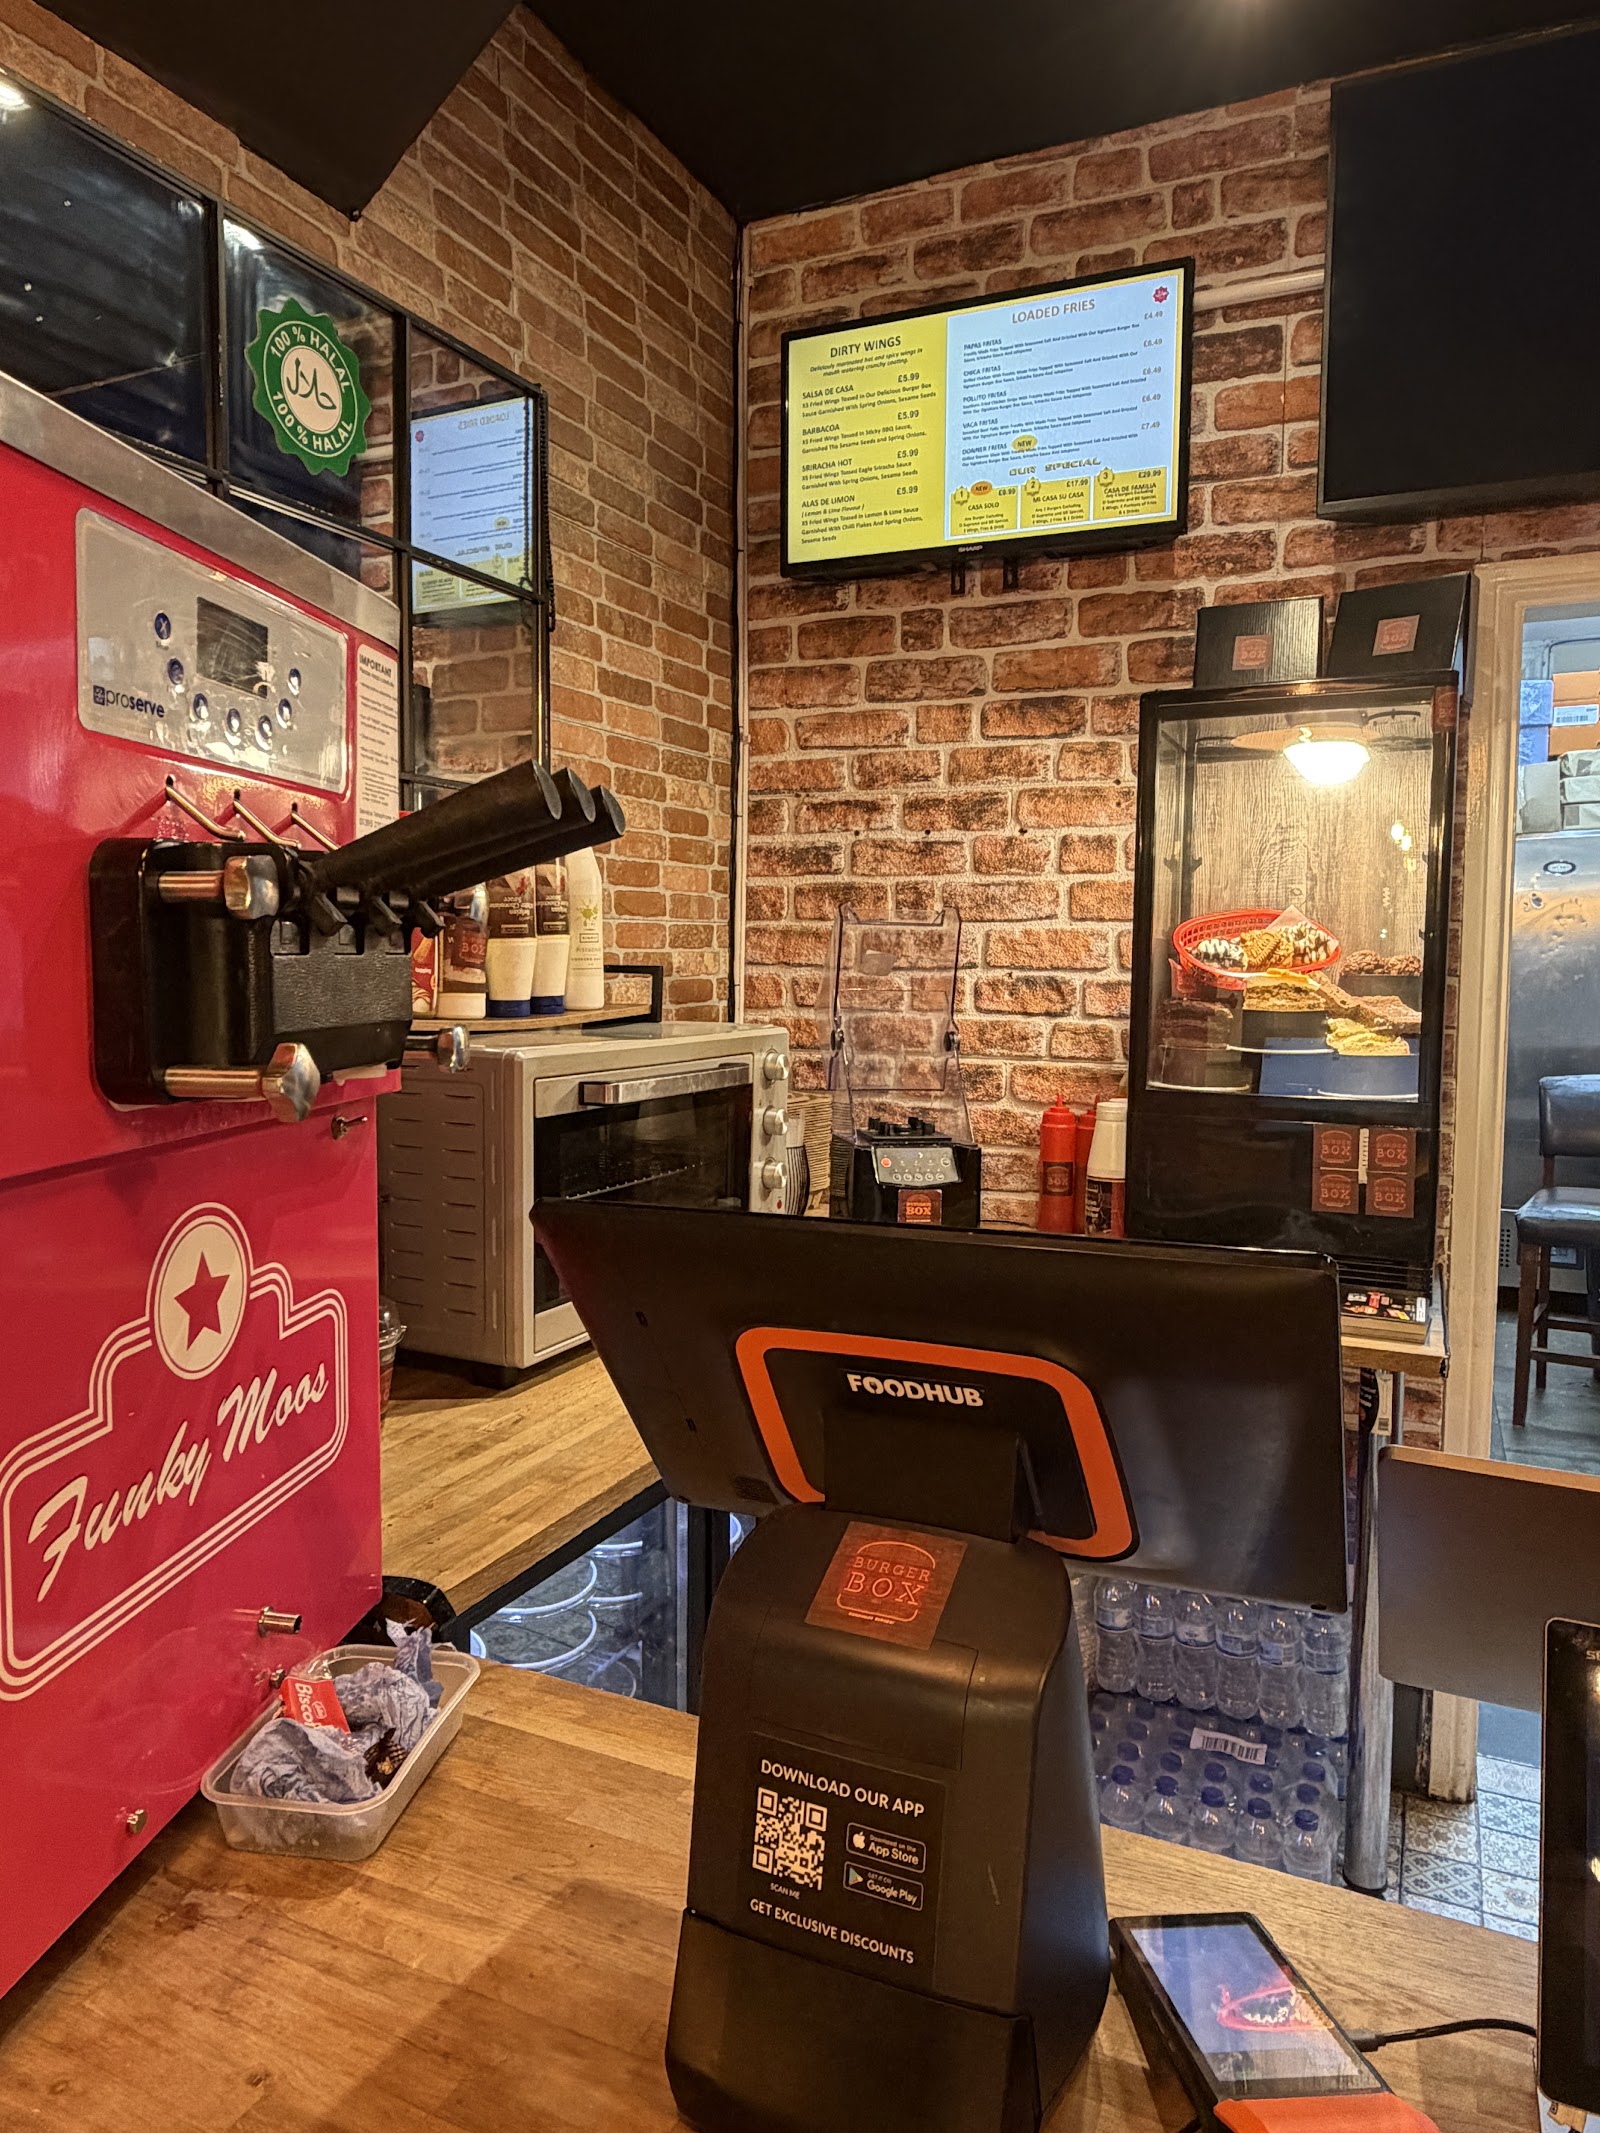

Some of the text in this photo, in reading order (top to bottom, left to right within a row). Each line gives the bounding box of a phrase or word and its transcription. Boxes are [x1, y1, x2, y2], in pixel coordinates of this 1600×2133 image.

[1012, 299, 1095, 323] LOADED FRIES
[1144, 310, 1162, 320] £4.49
[830, 335, 900, 357] DIRTY WINGS
[963, 338, 1001, 350] PAPAS FRITAS
[271, 326, 351, 393] 100 % HALAL
[963, 365, 1000, 376] CHICA FRITAS
[898, 372, 919, 382] £5.99
[287, 357, 337, 410] حلال
[802, 384, 853, 398] SALSA DE CASA
[963, 390, 1006, 402] POLLITO FRITAS
[824, 397, 839, 405] Wings
[897, 409, 918, 420] £5.99
[272, 392, 352, 451] 100 % HALAL
[979, 418, 997, 426] FRITAS
[1141, 421, 1160, 429] £7.49
[802, 423, 839, 435] BARBACOA
[897, 448, 918, 458] £5.99
[962, 446, 986, 454] DONNER
[802, 458, 852, 471] SRIRACHA HOT
[1009, 457, 1101, 476] OUR SPECIAL
[1103, 471, 1108, 479] 3
[1066, 478, 1088, 487] £17.99
[1104, 486, 1119, 494] CASA
[1131, 482, 1156, 490] FAMILIA
[896, 484, 918, 495] £5.99
[802, 494, 854, 507] ALAS DE LIMON
[360, 654, 392, 679] IMPORTANT
[106, 690, 164, 718] proserve
[1322, 1144, 1351, 1155] BOX
[1376, 1149, 1406, 1159] BOX
[1321, 1188, 1350, 1199] BOX
[1375, 1192, 1405, 1203] BOX
[906, 1206, 931, 1215] BOX
[847, 1373, 984, 1407] FOODHUB
[28, 1362, 328, 1602] Funky Moos
[853, 1556, 931, 1582] BURGER
[844, 1572, 925, 1605] BOX
[761, 1759, 925, 1818] DOWNLOAD OUR APP
[868, 1842, 919, 1865] App Store
[770, 1882, 800, 1900] SCAN ME
[867, 1879, 918, 1905] Google Play
[750, 1898, 915, 1964] GET EXCLUSIVE DISCOUNTS
